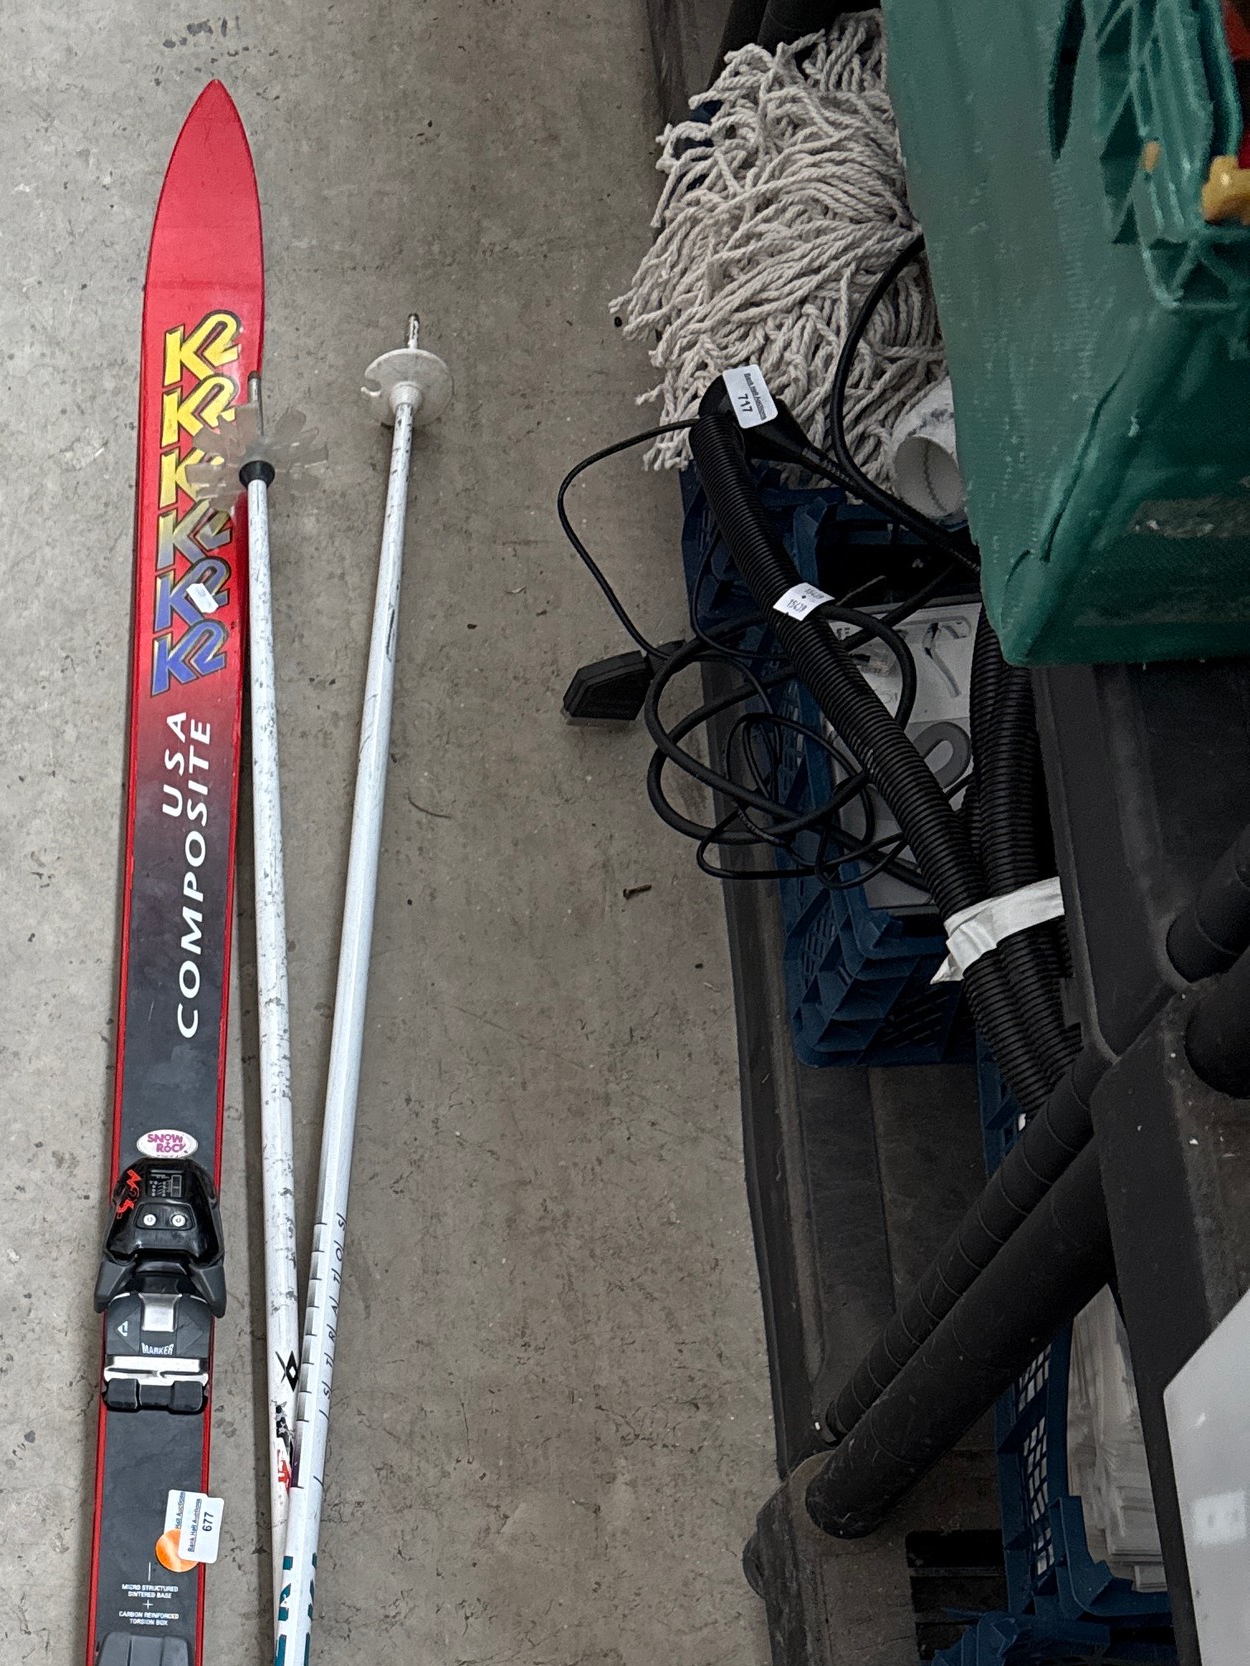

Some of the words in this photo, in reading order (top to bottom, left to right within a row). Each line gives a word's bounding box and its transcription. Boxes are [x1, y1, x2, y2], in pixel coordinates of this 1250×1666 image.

[738, 393, 753, 412] 717
[152, 618, 229, 698] K2
[162, 712, 187, 817] USA
[177, 718, 212, 1039] COMPOSITE
[141, 1342, 174, 1355] MARKER
[202, 1511, 214, 1532] 677
